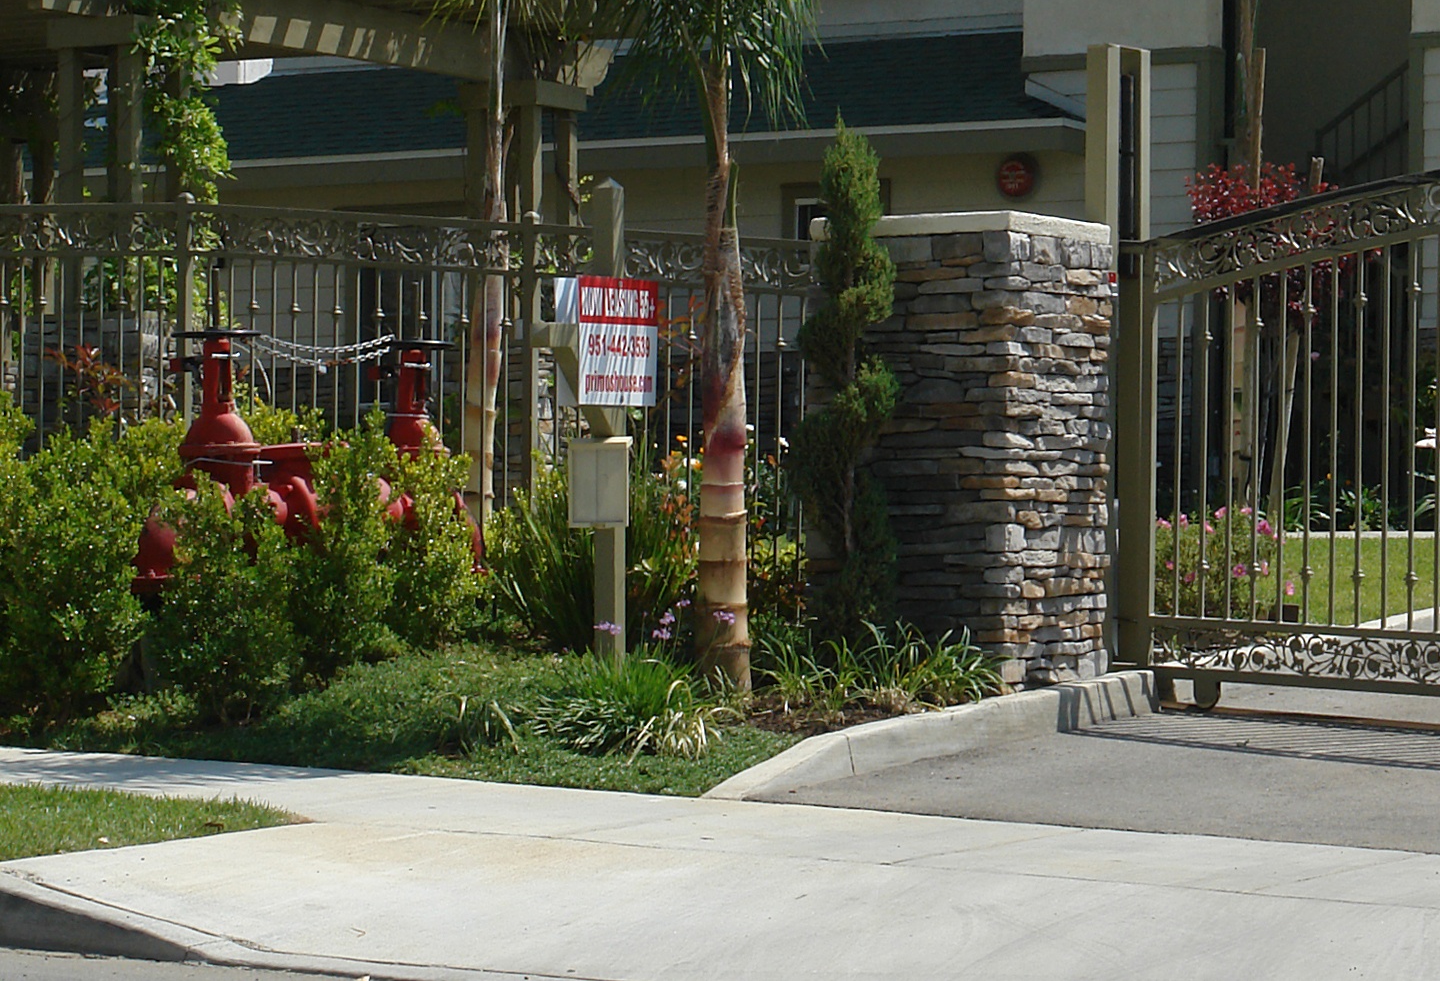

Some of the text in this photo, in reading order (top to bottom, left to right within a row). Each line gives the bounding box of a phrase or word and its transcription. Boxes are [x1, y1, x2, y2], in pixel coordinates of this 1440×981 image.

[581, 286, 656, 319] NOW LEASING 55+
[588, 333, 651, 358] 951-442-3539
[585, 370, 653, 395] primoshouse.com
